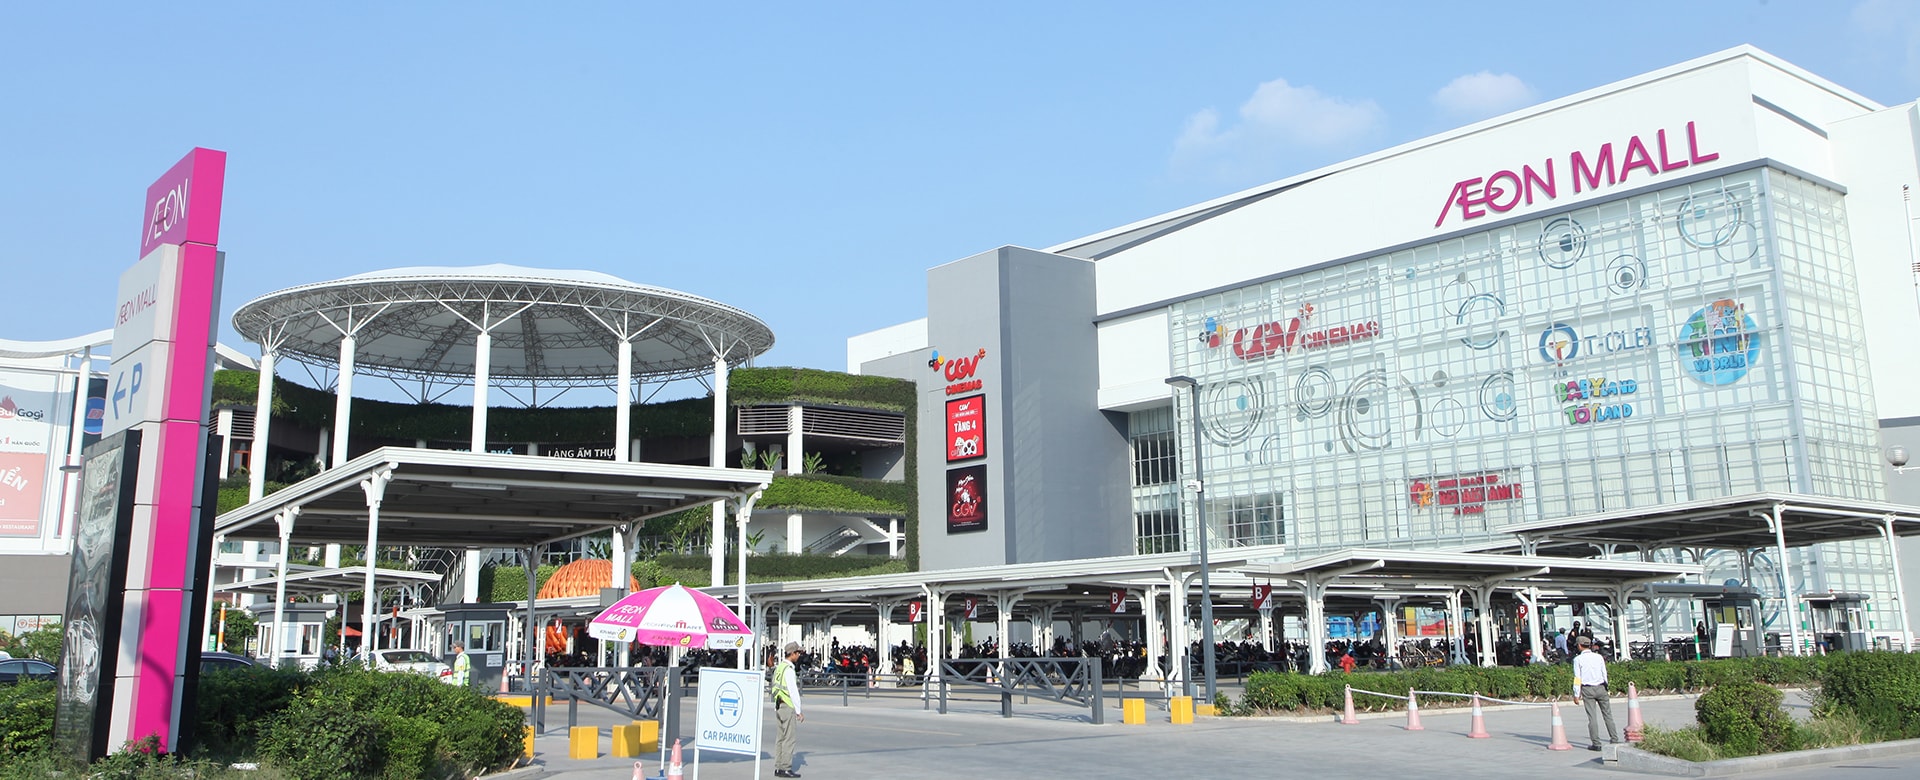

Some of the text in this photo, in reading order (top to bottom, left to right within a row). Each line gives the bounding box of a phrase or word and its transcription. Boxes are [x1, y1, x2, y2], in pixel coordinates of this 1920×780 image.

[1570, 121, 1720, 193] MALL
[136, 284, 156, 315] MALL
[1233, 317, 1379, 361] CGV CINEMAS
[945, 355, 979, 382] CGV
[1693, 354, 1746, 372] WORLD
[129, 362, 143, 413] P
[946, 379, 982, 396] CINEMAS
[971, 420, 977, 430] 4
[1112, 592, 1119, 604] B
[1254, 586, 1263, 600] B
[910, 603, 916, 614] B
[966, 600, 972, 610] B
[1264, 599, 1272, 608] 11
[1519, 606, 1526, 614] B
[604, 613, 632, 624] MALL
[703, 730, 751, 745] CAR PARKING
